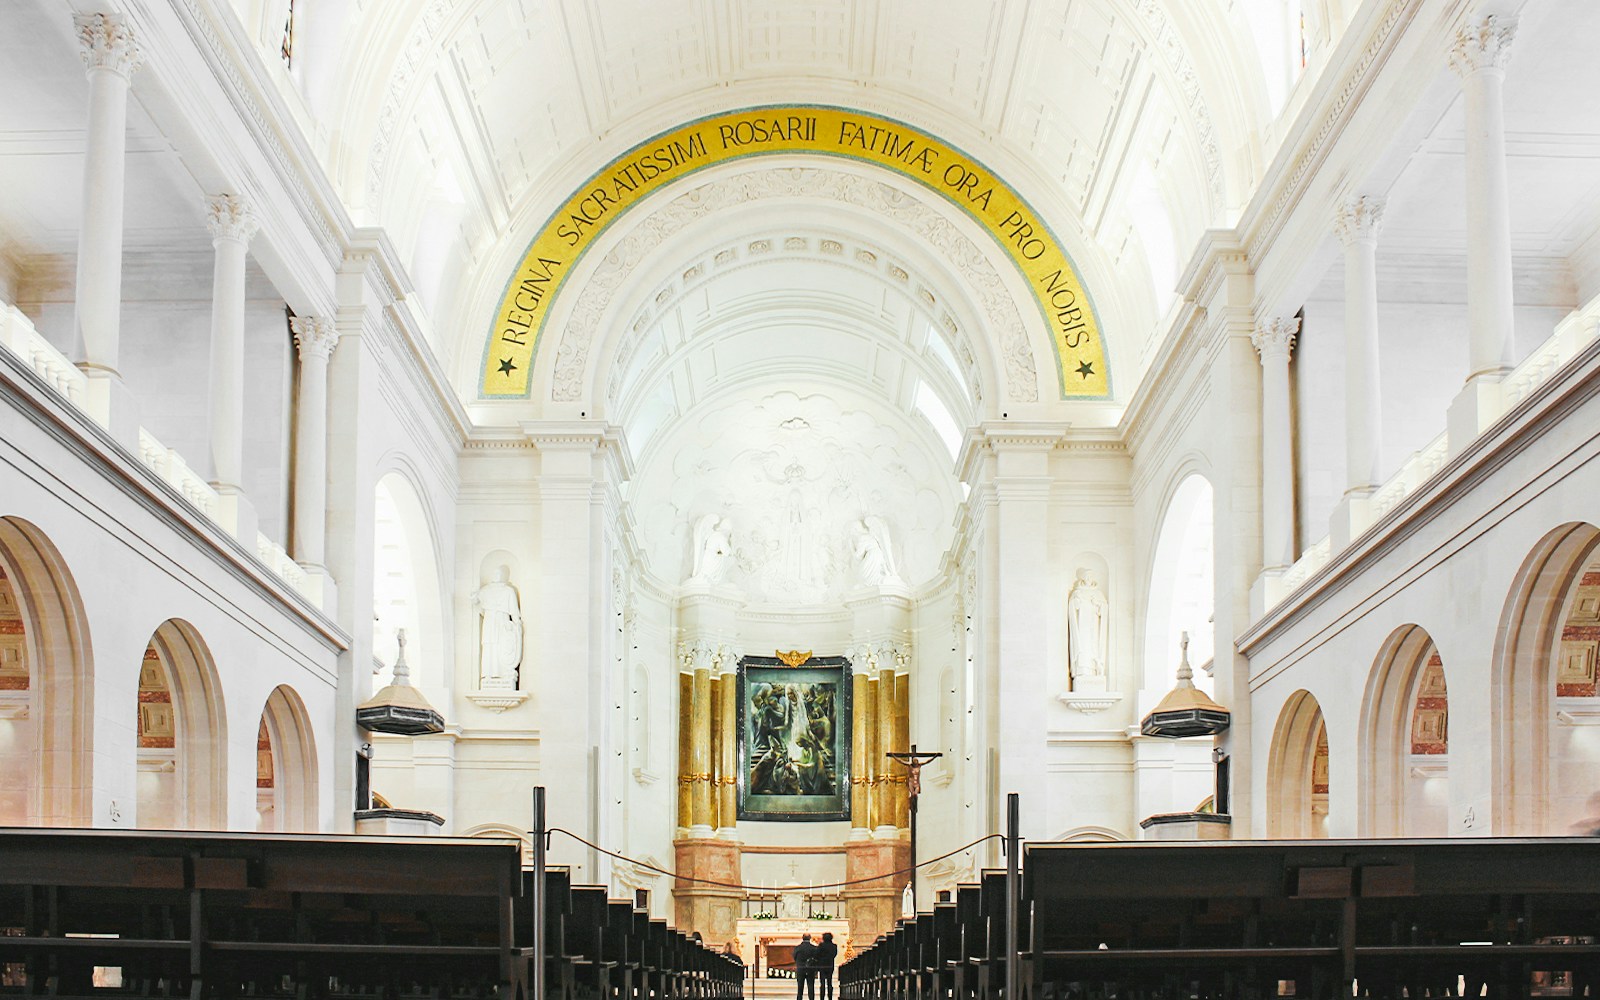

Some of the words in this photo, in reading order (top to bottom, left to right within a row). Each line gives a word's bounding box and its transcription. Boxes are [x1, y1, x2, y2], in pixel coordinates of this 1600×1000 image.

[502, 257, 562, 346] REGINA
[557, 131, 708, 247] SACRATISSIMI
[718, 116, 817, 150] ROSARII
[838, 119, 939, 174] FATIMÆ
[943, 163, 993, 212] ORA
[998, 210, 1046, 260] PRO
[1040, 270, 1090, 349] NOBIS
